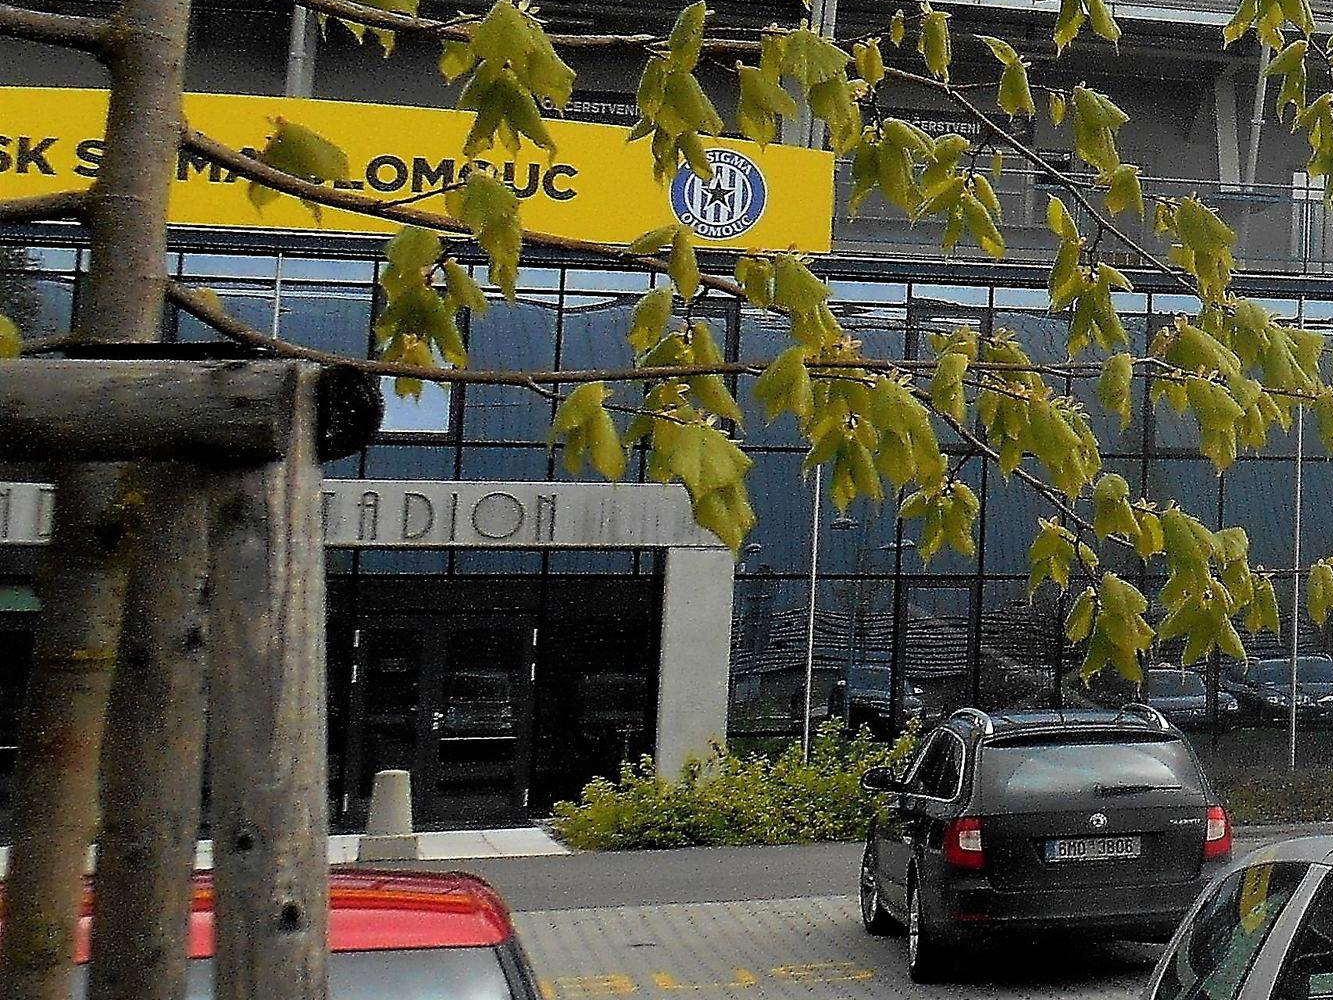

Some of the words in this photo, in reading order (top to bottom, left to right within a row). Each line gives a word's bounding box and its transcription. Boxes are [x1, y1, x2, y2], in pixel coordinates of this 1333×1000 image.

[308, 154, 578, 201] OMUC
[706, 151, 752, 175] SIGMA
[680, 214, 753, 237] OLOMOUC
[322, 490, 558, 541] TADION
